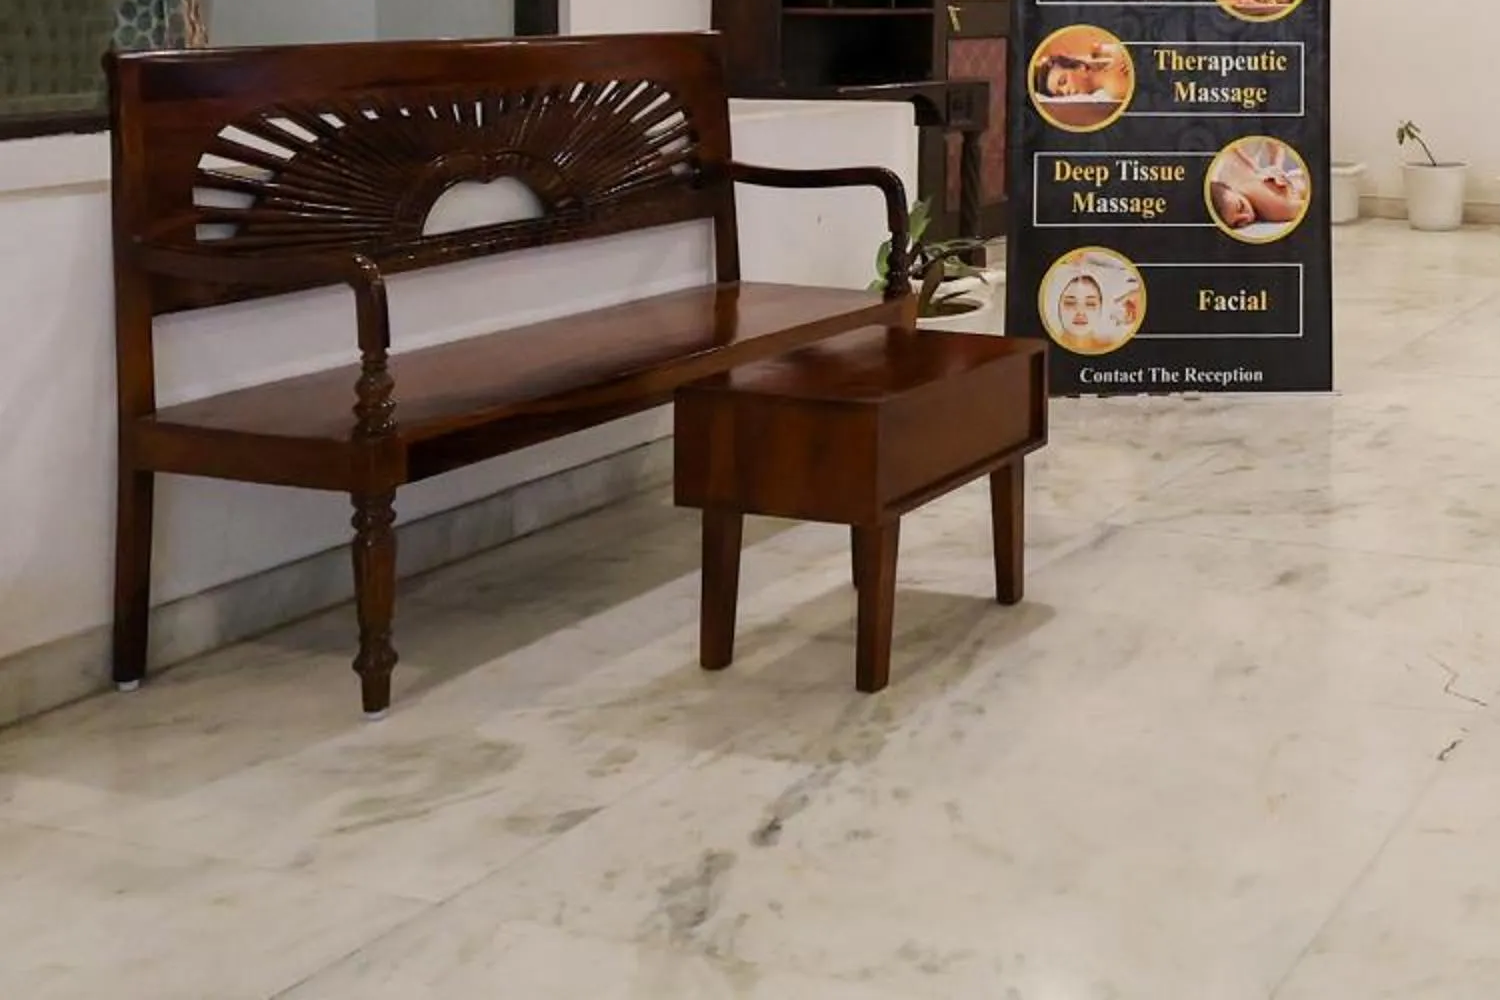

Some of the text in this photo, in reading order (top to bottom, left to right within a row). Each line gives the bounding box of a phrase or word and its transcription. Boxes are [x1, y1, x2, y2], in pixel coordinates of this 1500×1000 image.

[1154, 50, 1287, 75] Therapeutic
[1174, 82, 1267, 107] Massage
[1054, 159, 1185, 186] Deep Tissue
[1072, 192, 1167, 218] Massage
[1199, 290, 1267, 311] Facial
[1079, 367, 1263, 386] Contact The Reception
